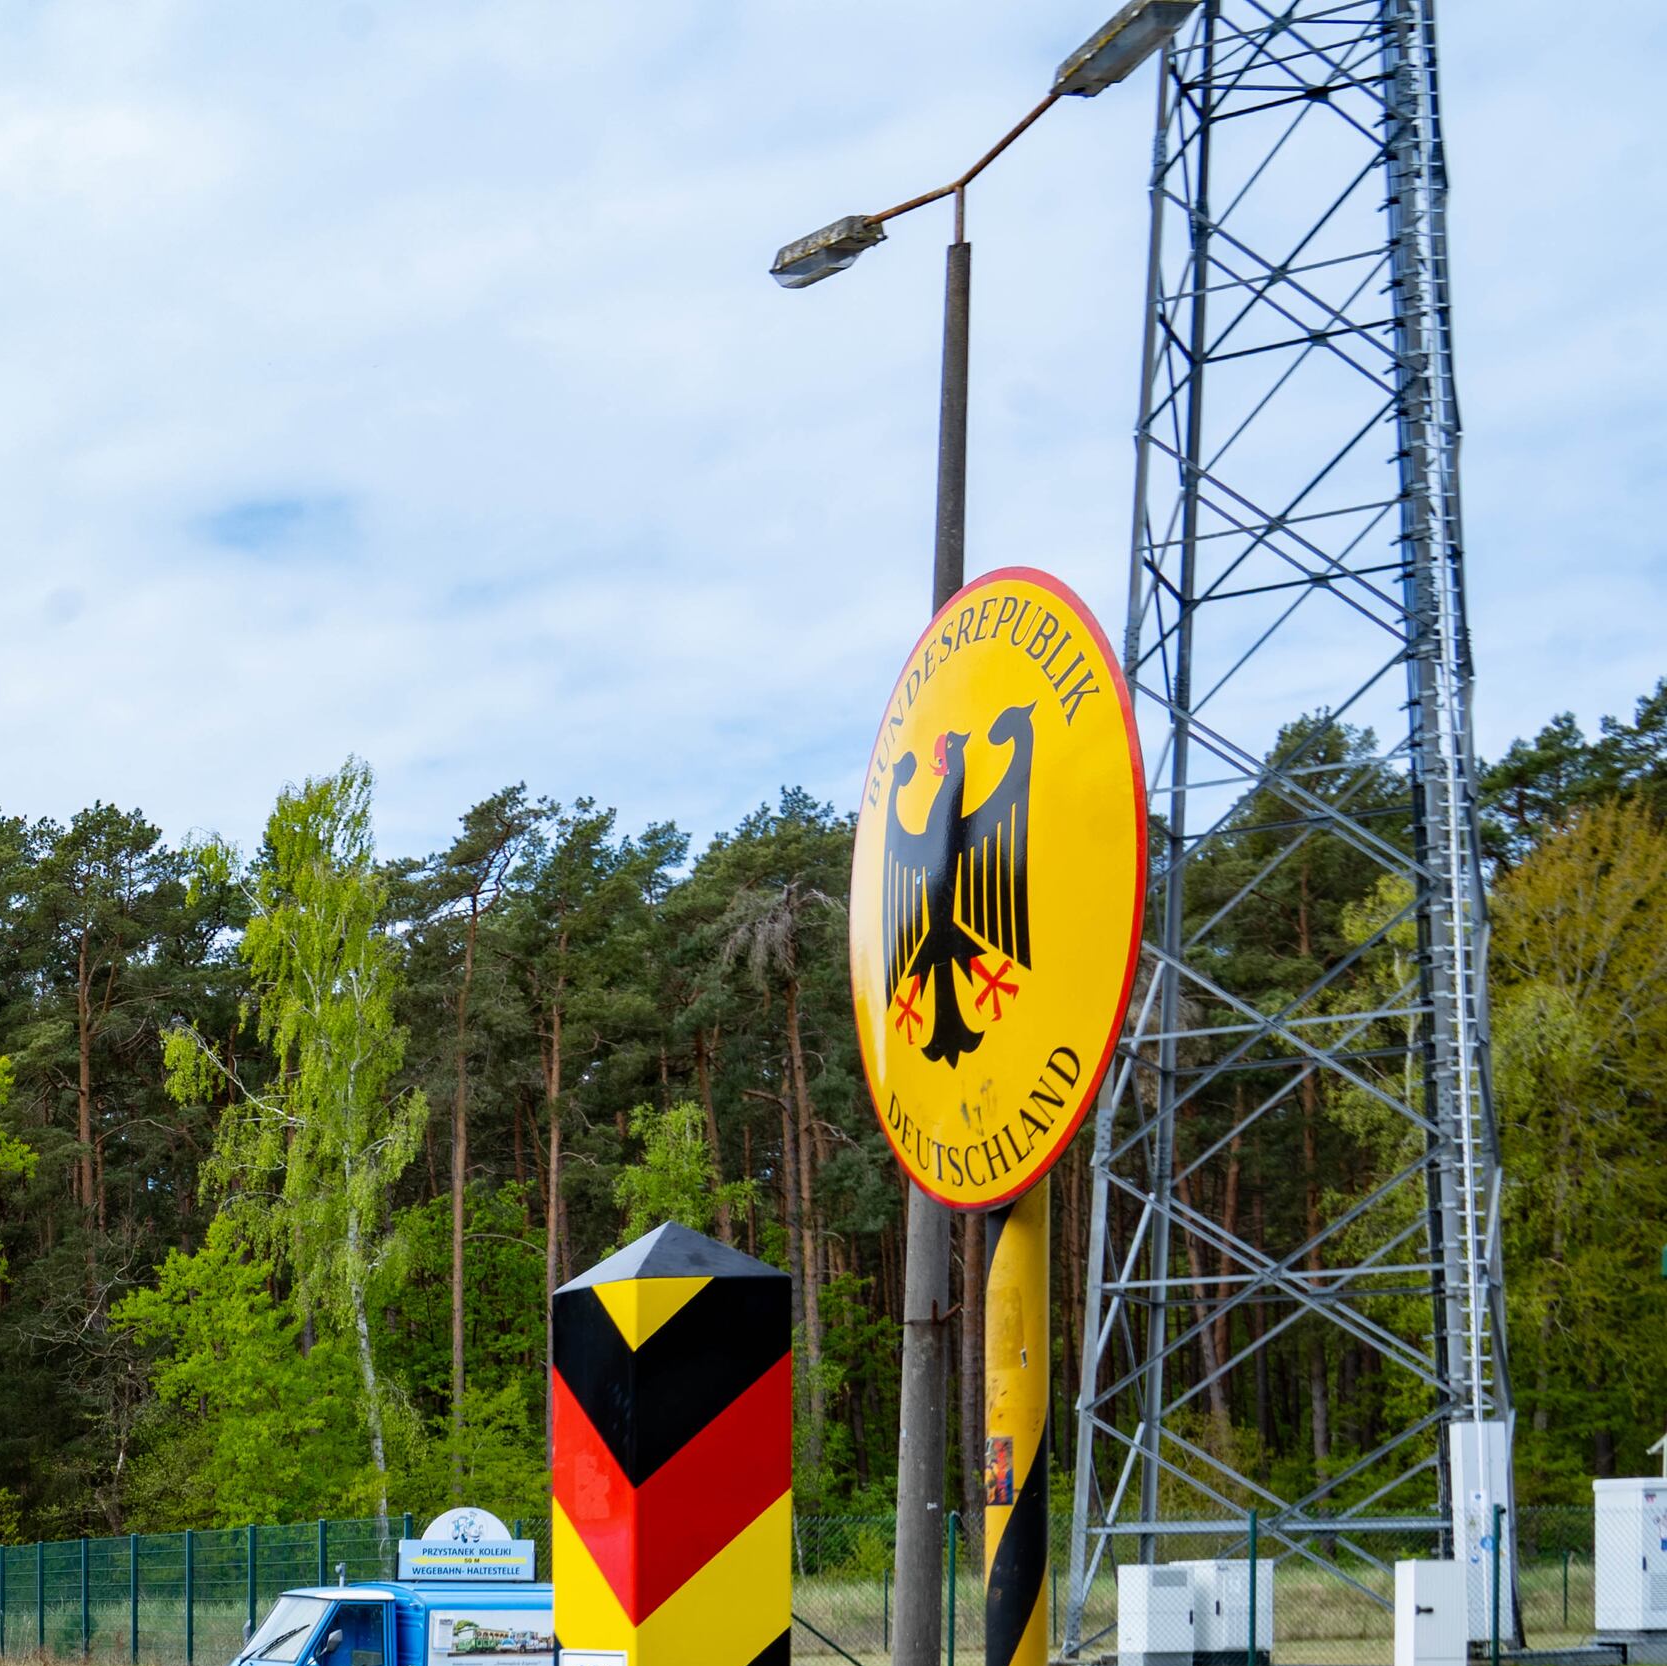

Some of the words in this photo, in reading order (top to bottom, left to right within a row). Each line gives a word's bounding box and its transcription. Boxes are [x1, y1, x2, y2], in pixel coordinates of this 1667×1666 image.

[868, 596, 1100, 808] BUNDESREPUBLIK
[888, 1046, 1081, 1187] DEUTSCHLAND
[412, 1567, 465, 1575] WEGEBAHN-
[467, 1567, 520, 1575] HALTESTELLE
